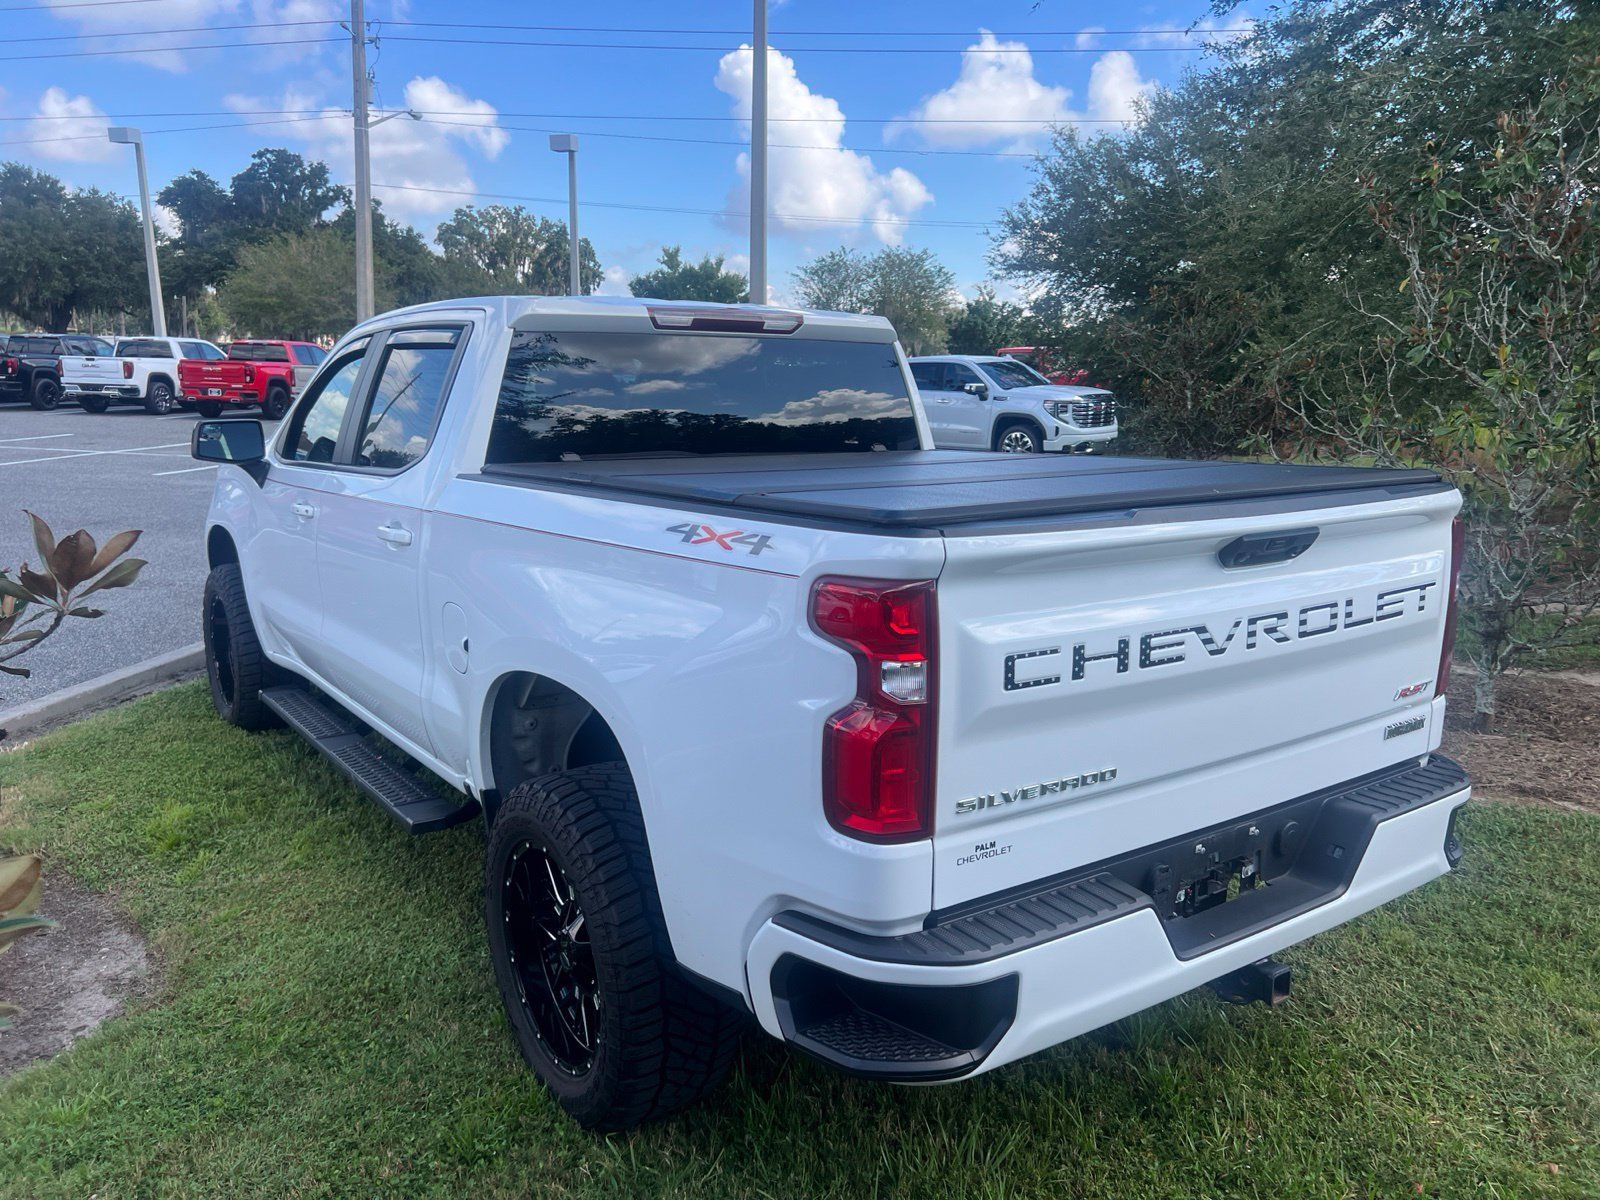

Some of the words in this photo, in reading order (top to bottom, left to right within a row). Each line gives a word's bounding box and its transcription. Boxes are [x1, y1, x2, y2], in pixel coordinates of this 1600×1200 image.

[1003, 581, 1437, 692] CHEVROLET
[955, 767, 1118, 814] SILVERADO
[956, 844, 1014, 866] CHEVROLET
[974, 840, 997, 853] PALM
